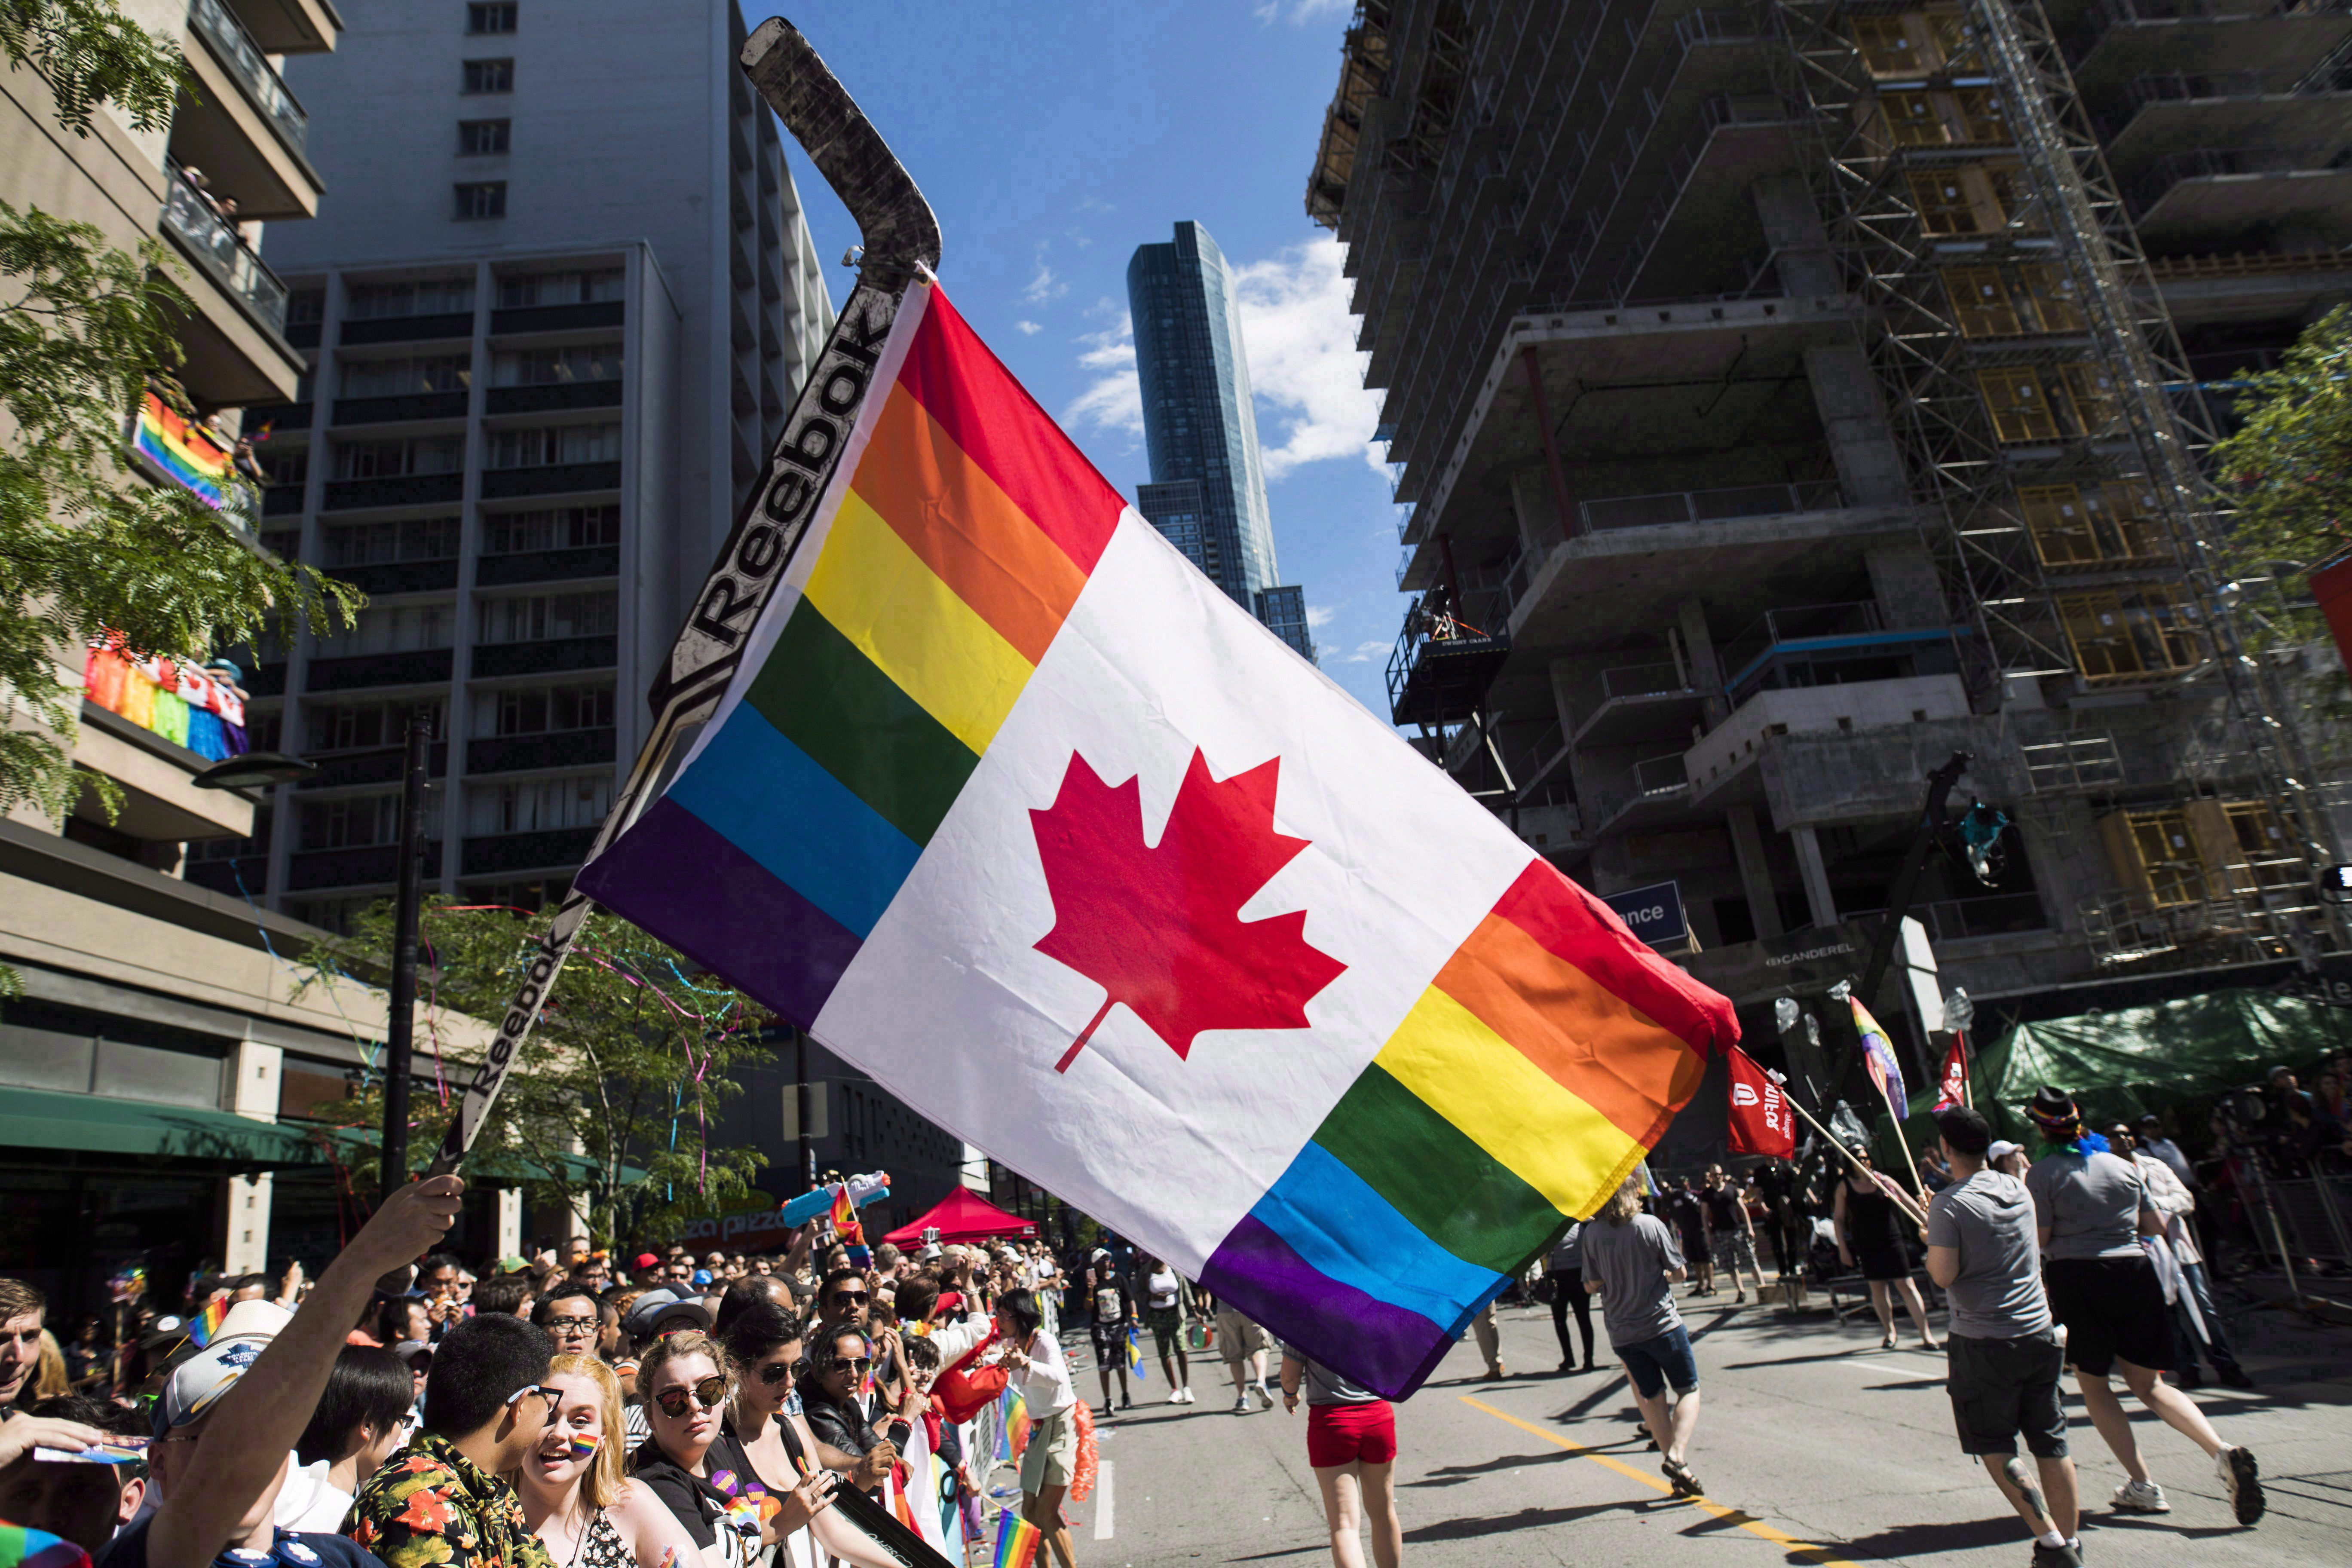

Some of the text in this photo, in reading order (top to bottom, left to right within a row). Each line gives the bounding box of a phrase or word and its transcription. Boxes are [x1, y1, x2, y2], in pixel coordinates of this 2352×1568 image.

[689, 301, 892, 648] Reebok
[471, 927, 571, 1098] Reebok
[1782, 942, 1856, 965] CANDEREL
